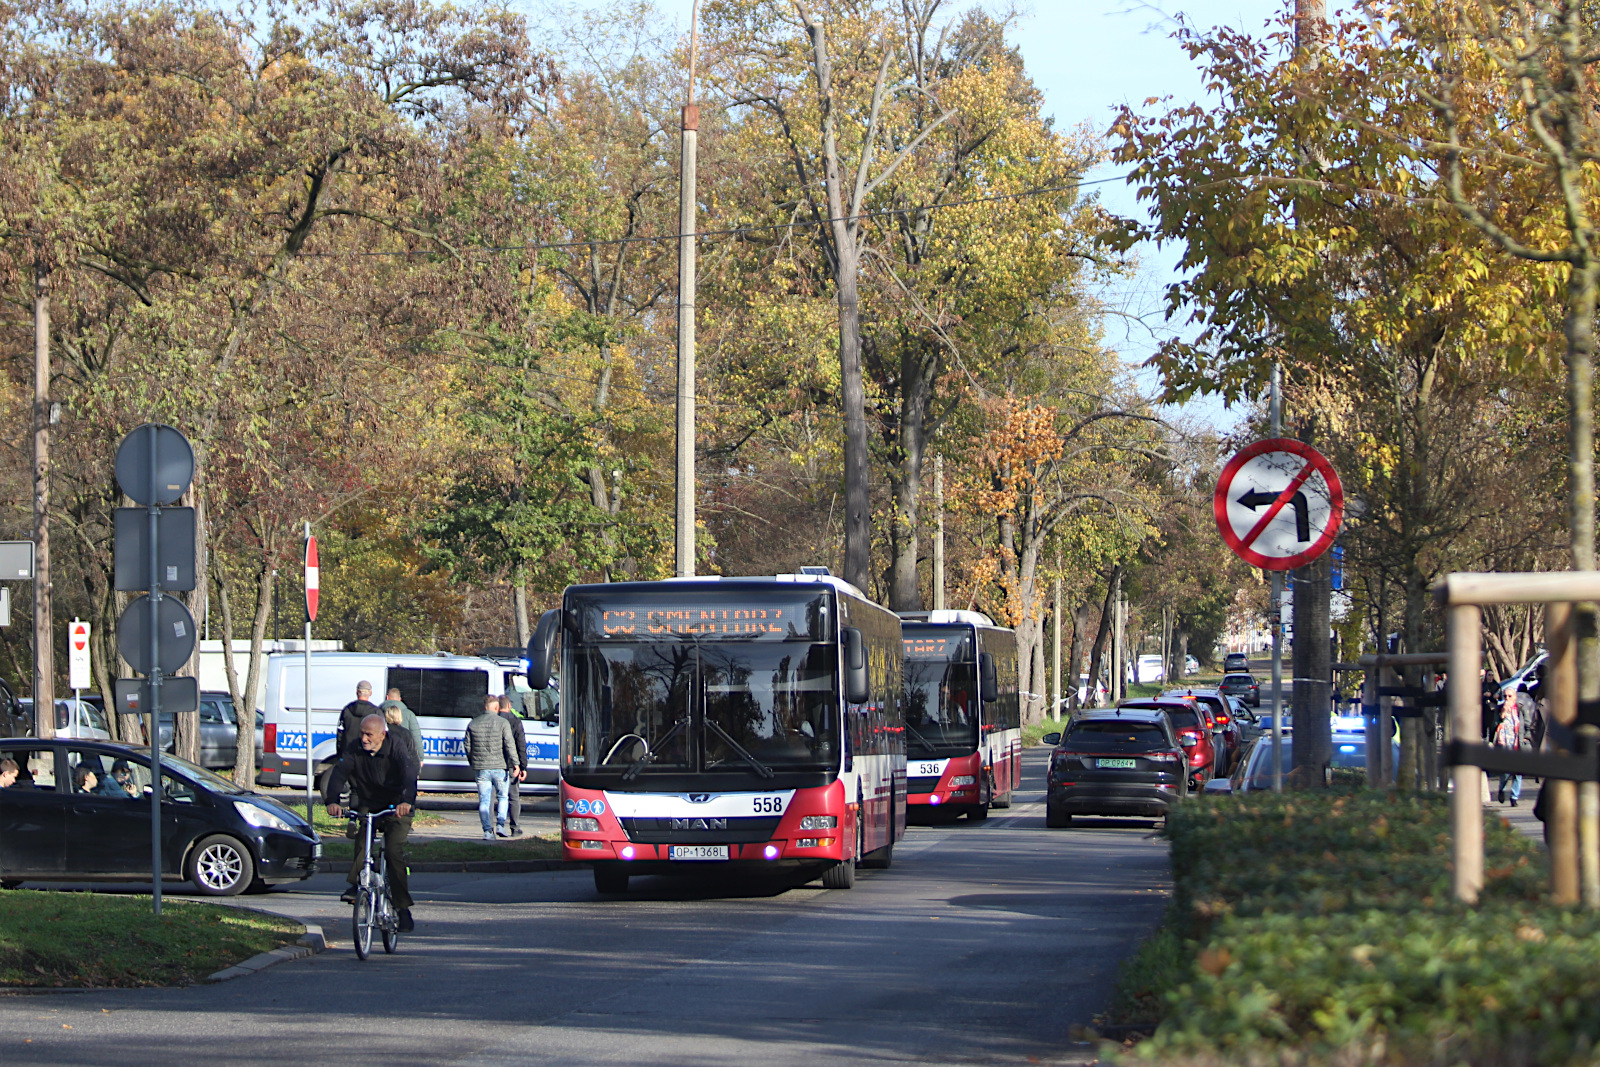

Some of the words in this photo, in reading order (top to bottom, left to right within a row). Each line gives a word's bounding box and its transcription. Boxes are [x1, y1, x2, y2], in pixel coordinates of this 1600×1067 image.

[422, 739, 466, 754] OLICJA
[920, 763, 939, 774] 536
[753, 797, 782, 813] 558
[671, 818, 727, 830] MAN
